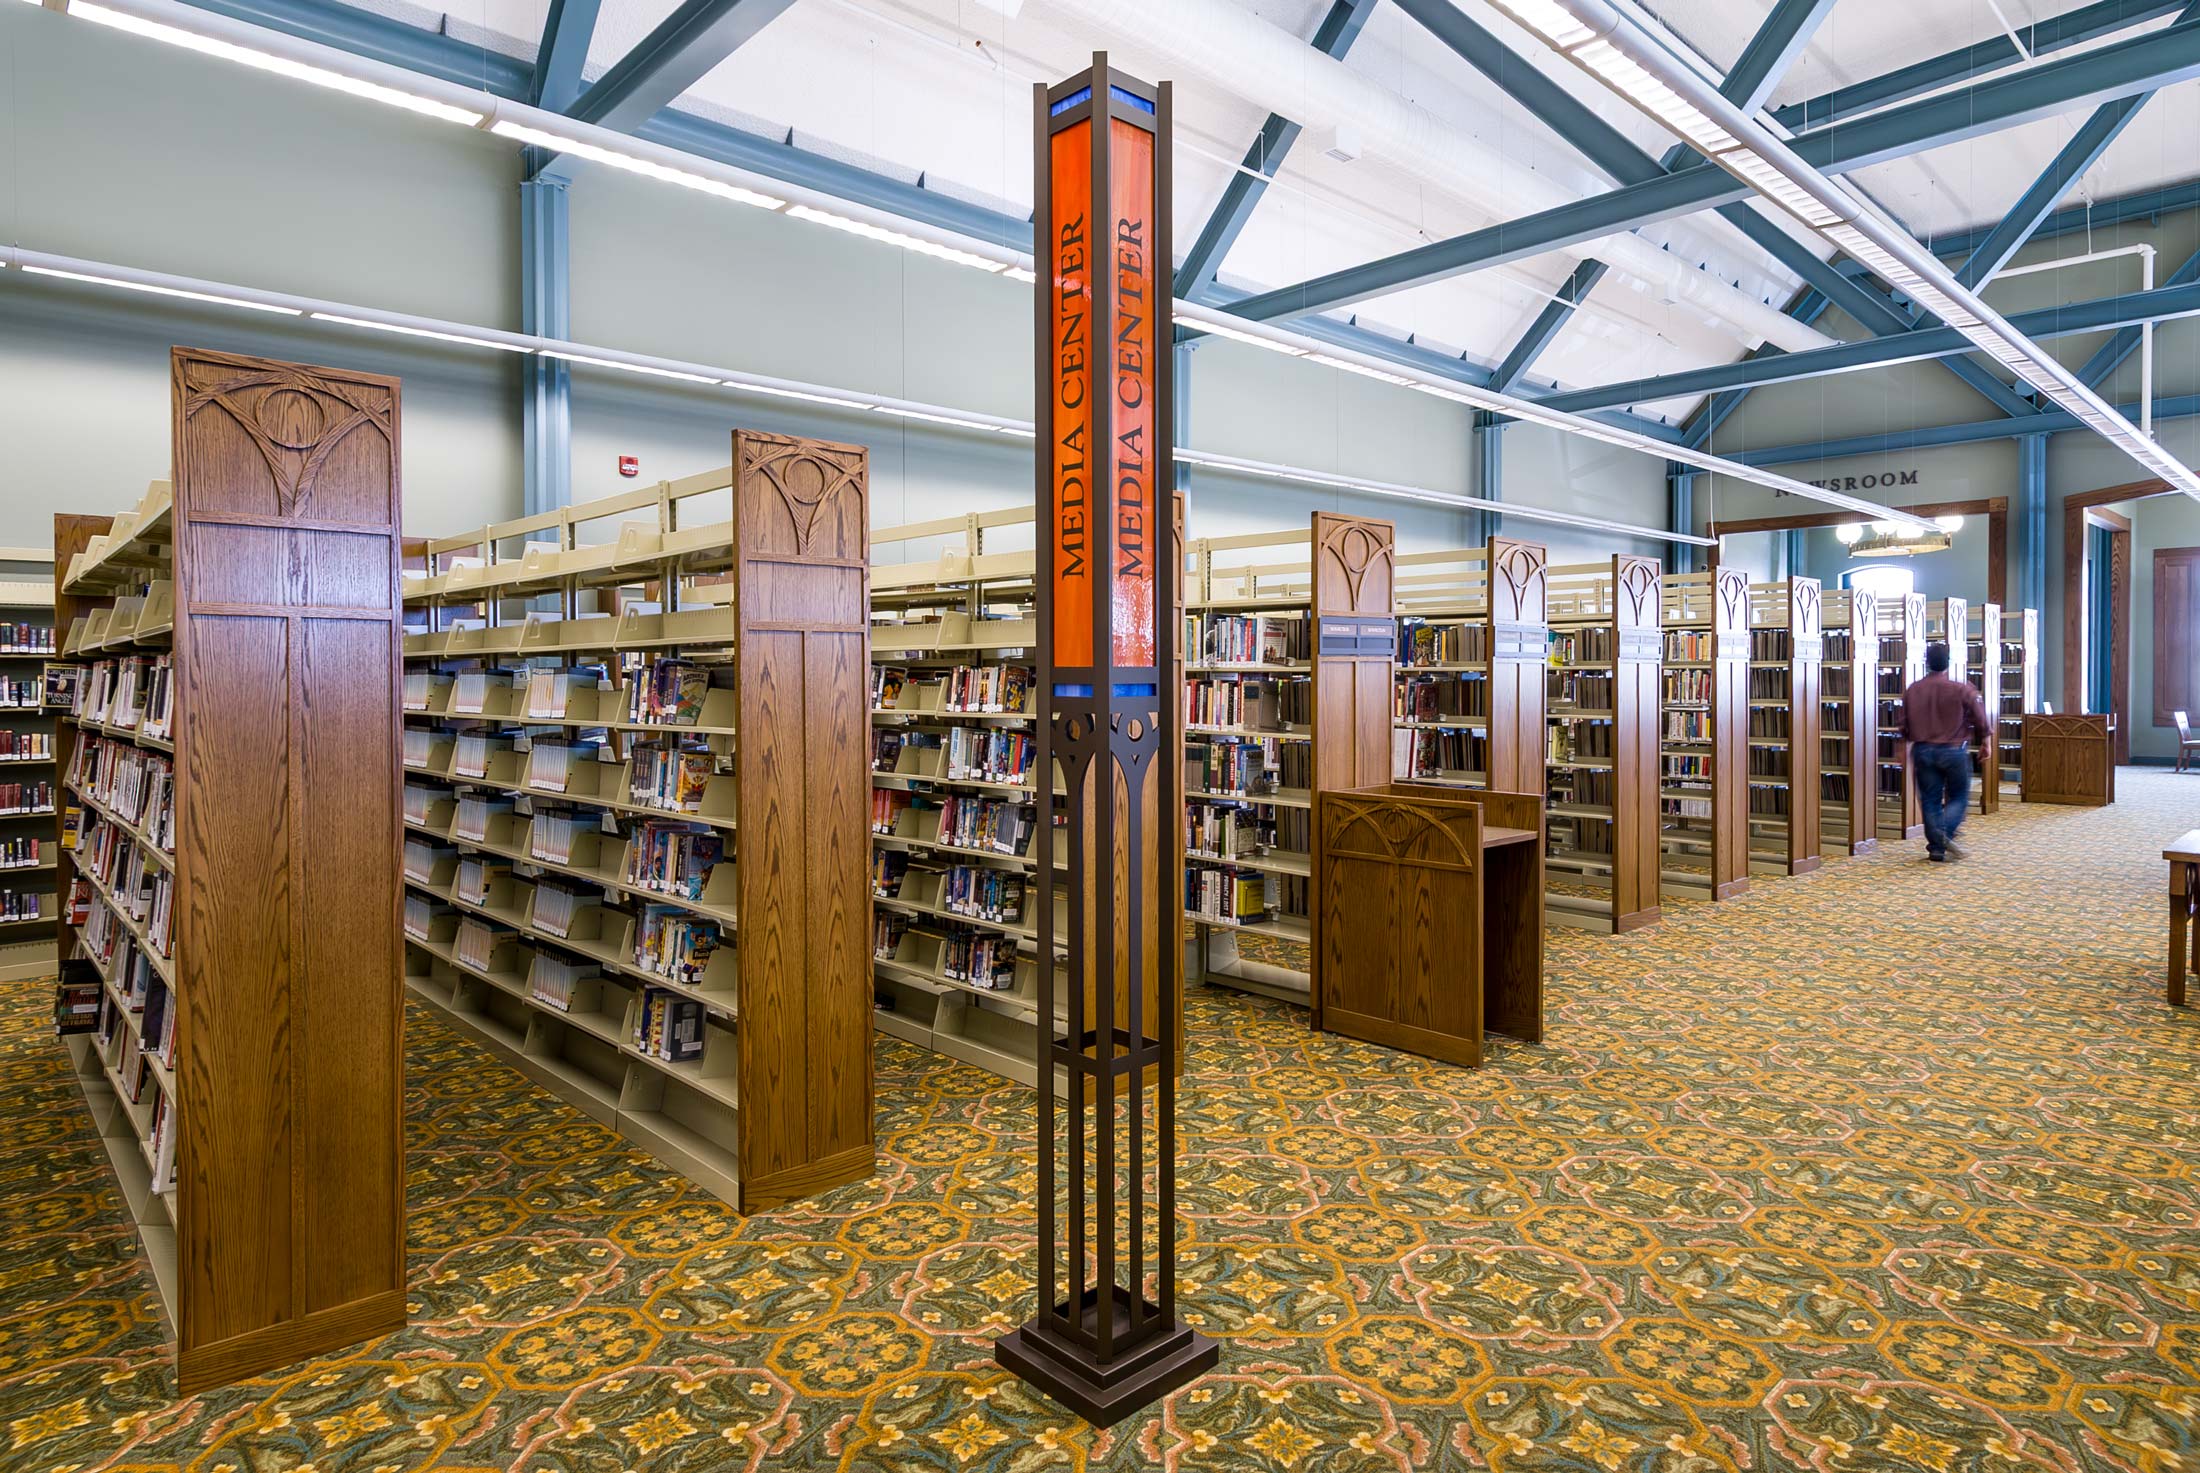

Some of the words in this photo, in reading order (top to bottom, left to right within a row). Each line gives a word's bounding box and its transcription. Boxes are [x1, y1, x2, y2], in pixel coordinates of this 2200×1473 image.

[1061, 212, 1085, 409] CENTER
[1117, 218, 1143, 409] CENTER
[1061, 421, 1085, 580] MEDIA
[1118, 424, 1143, 580] MEDIA
[1775, 470, 1918, 498] NWSROOM
